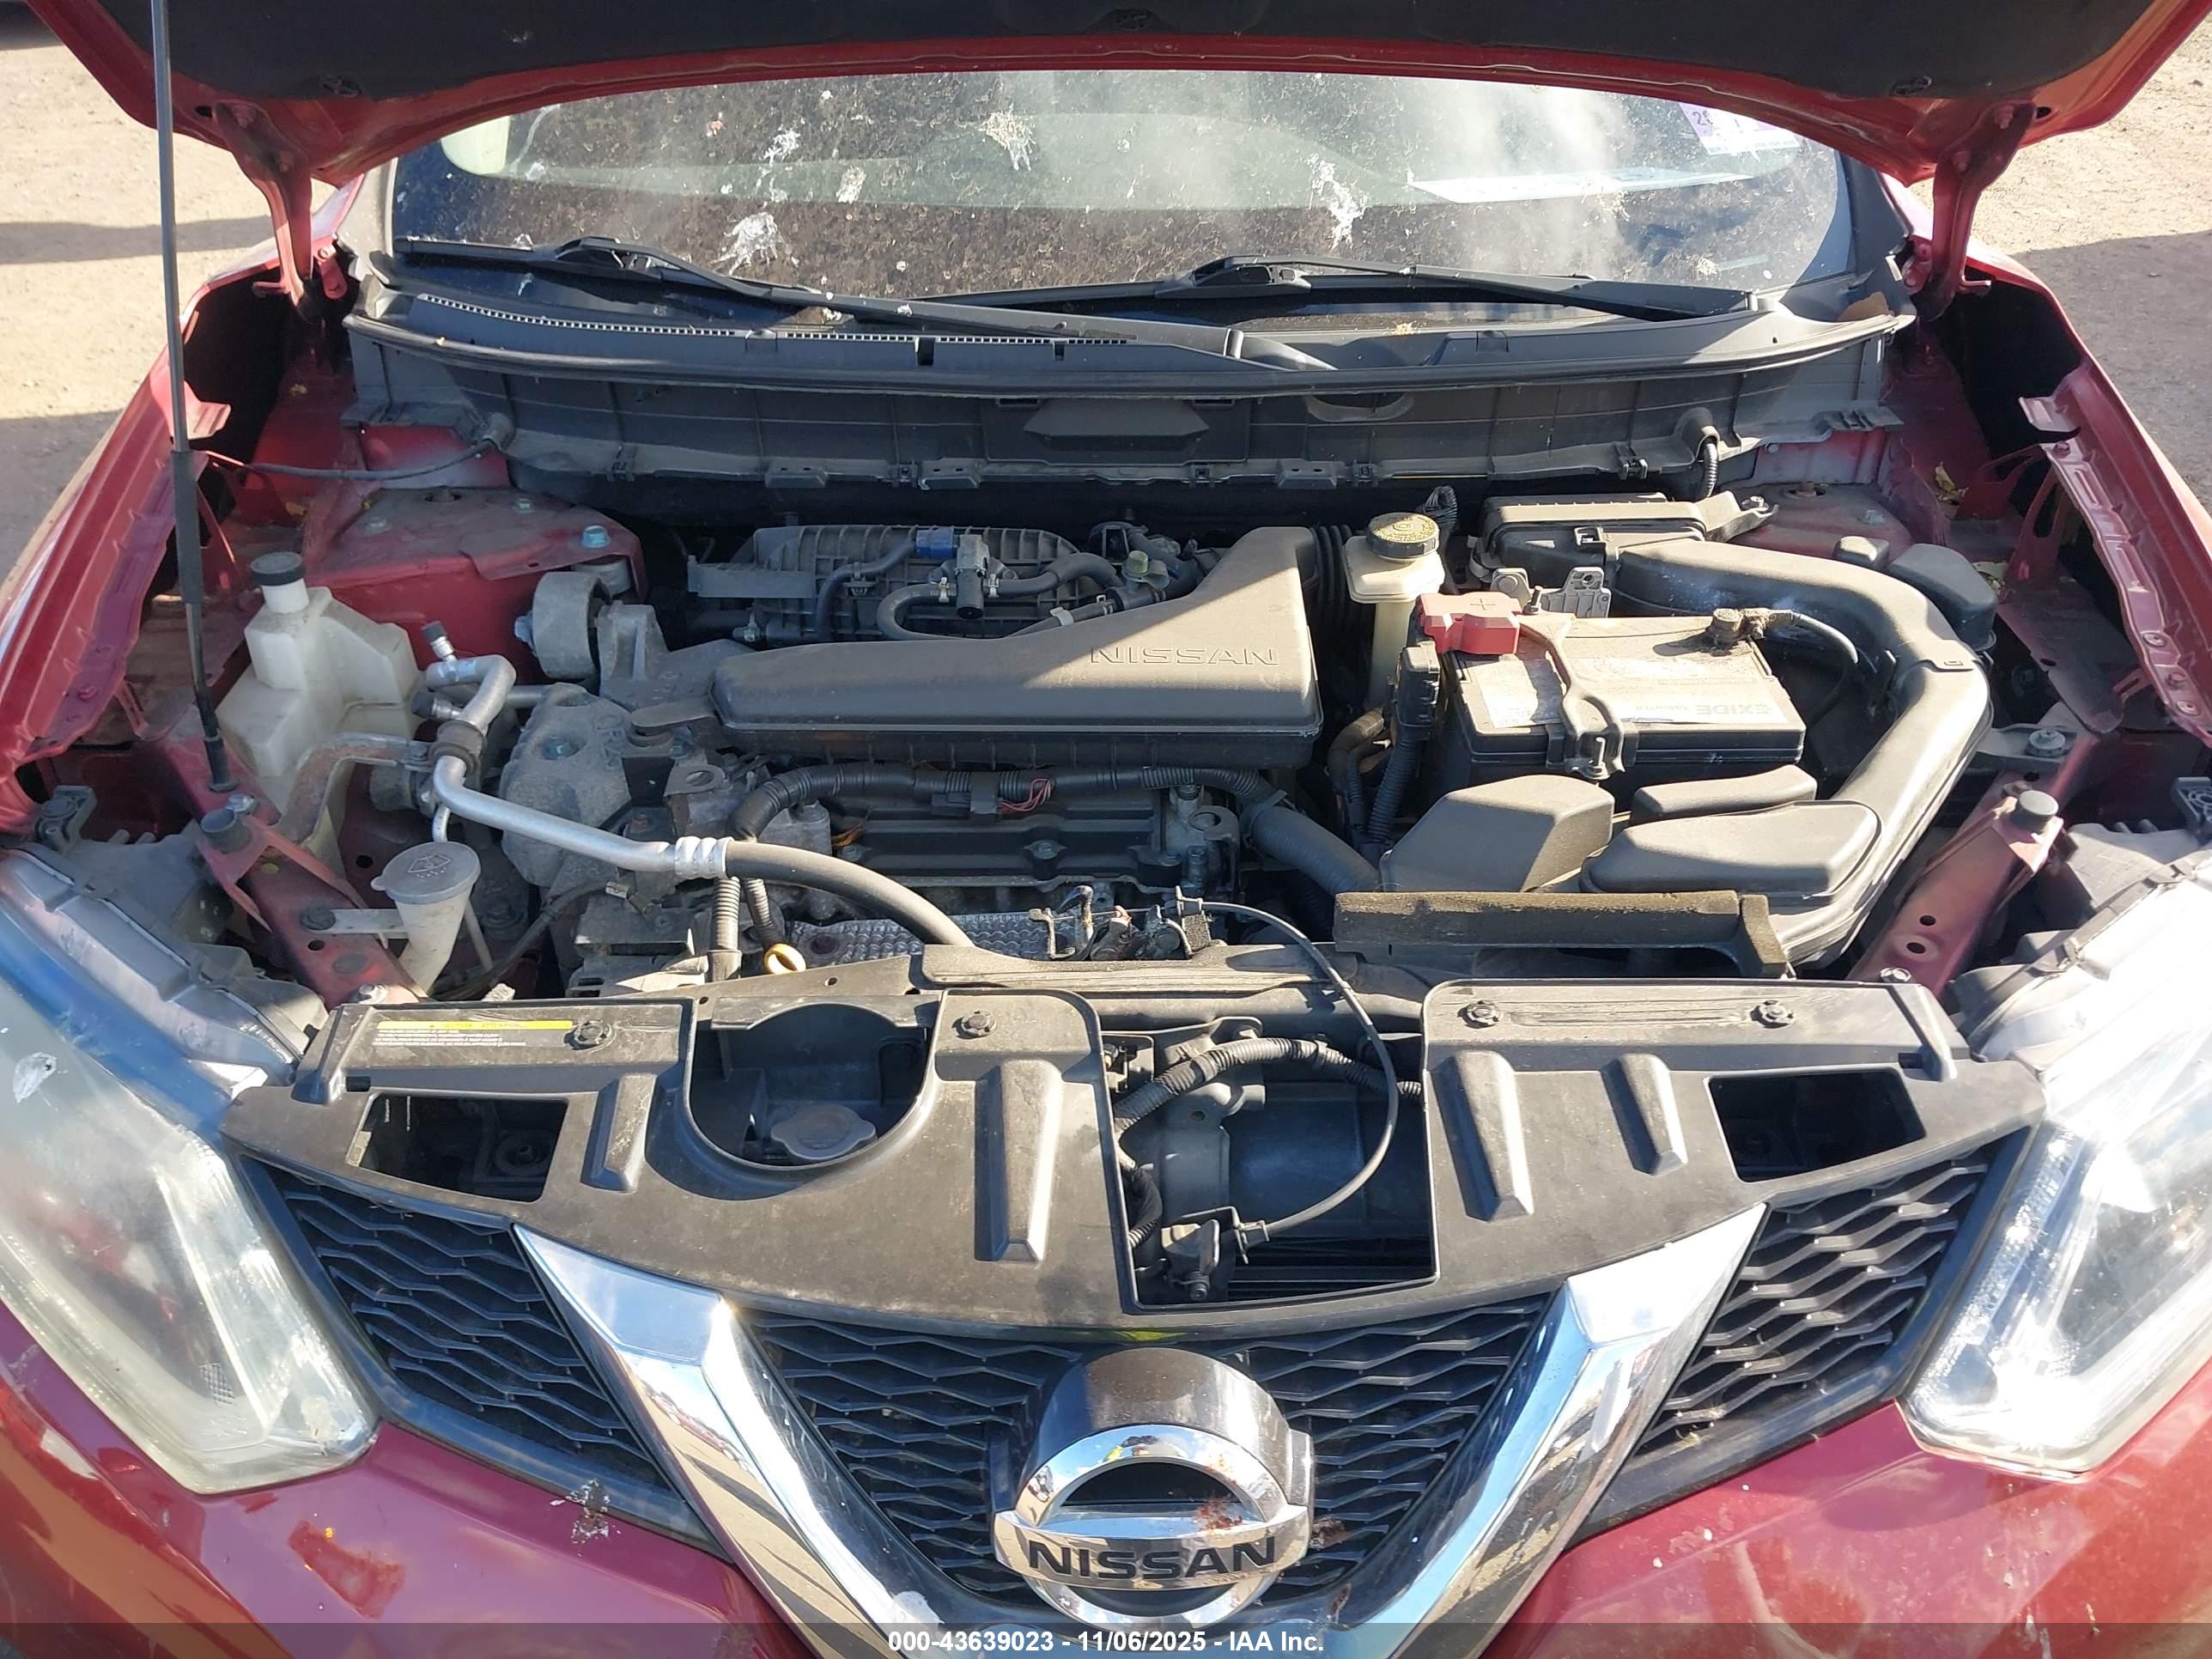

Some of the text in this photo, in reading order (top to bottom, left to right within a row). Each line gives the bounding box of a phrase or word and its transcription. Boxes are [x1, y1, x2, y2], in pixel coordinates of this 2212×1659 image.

[1091, 646, 1279, 665] NISSAN
[1697, 704, 1773, 715] EXIDE
[1030, 1536, 1275, 1579] NISSAN
